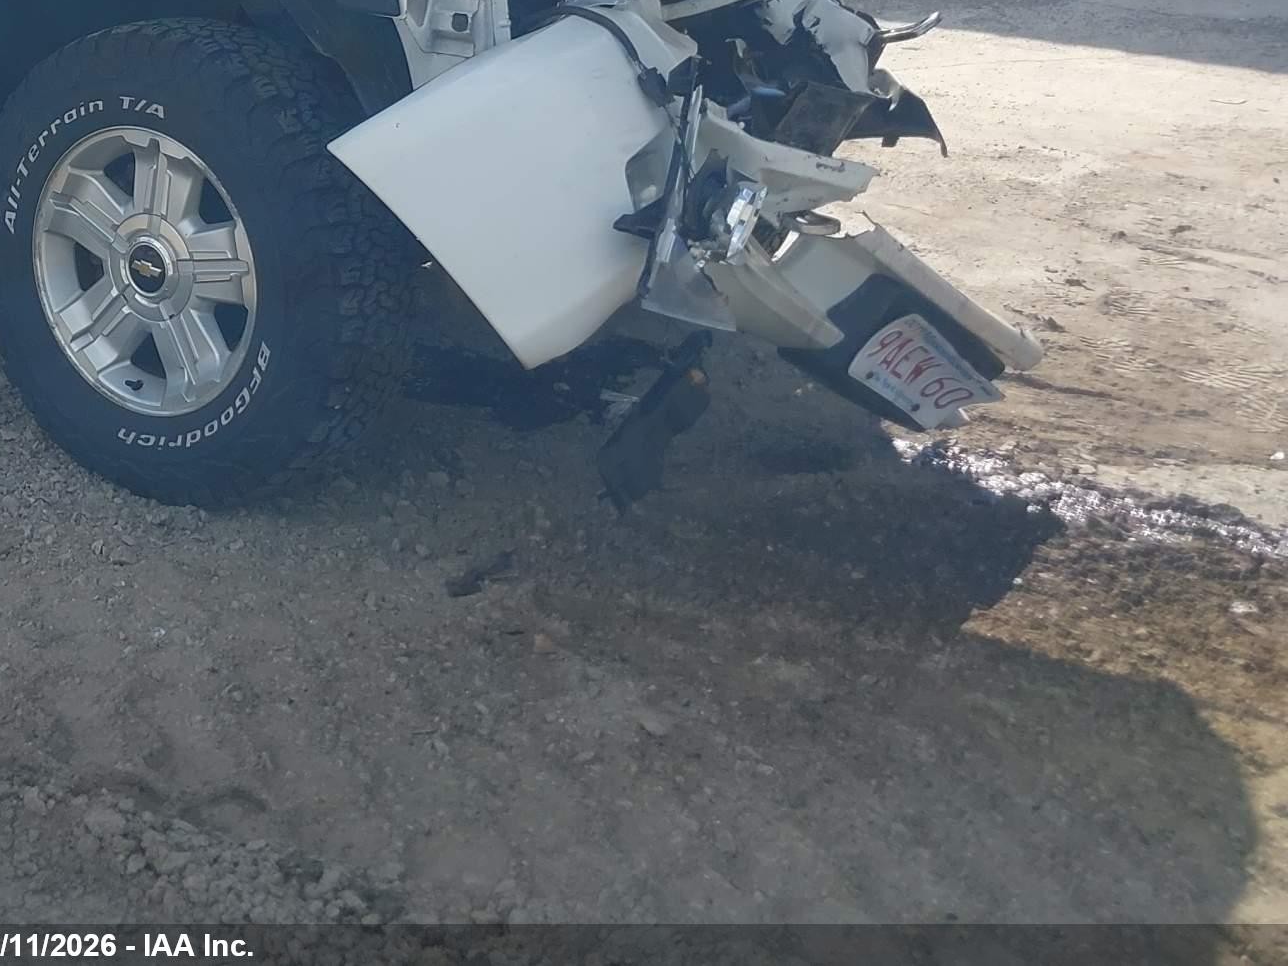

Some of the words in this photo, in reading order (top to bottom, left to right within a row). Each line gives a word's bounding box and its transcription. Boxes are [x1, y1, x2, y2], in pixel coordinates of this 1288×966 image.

[3, 97, 104, 234] All-Terrain
[119, 95, 167, 119] T/A
[117, 340, 272, 448] BFGoodrich
